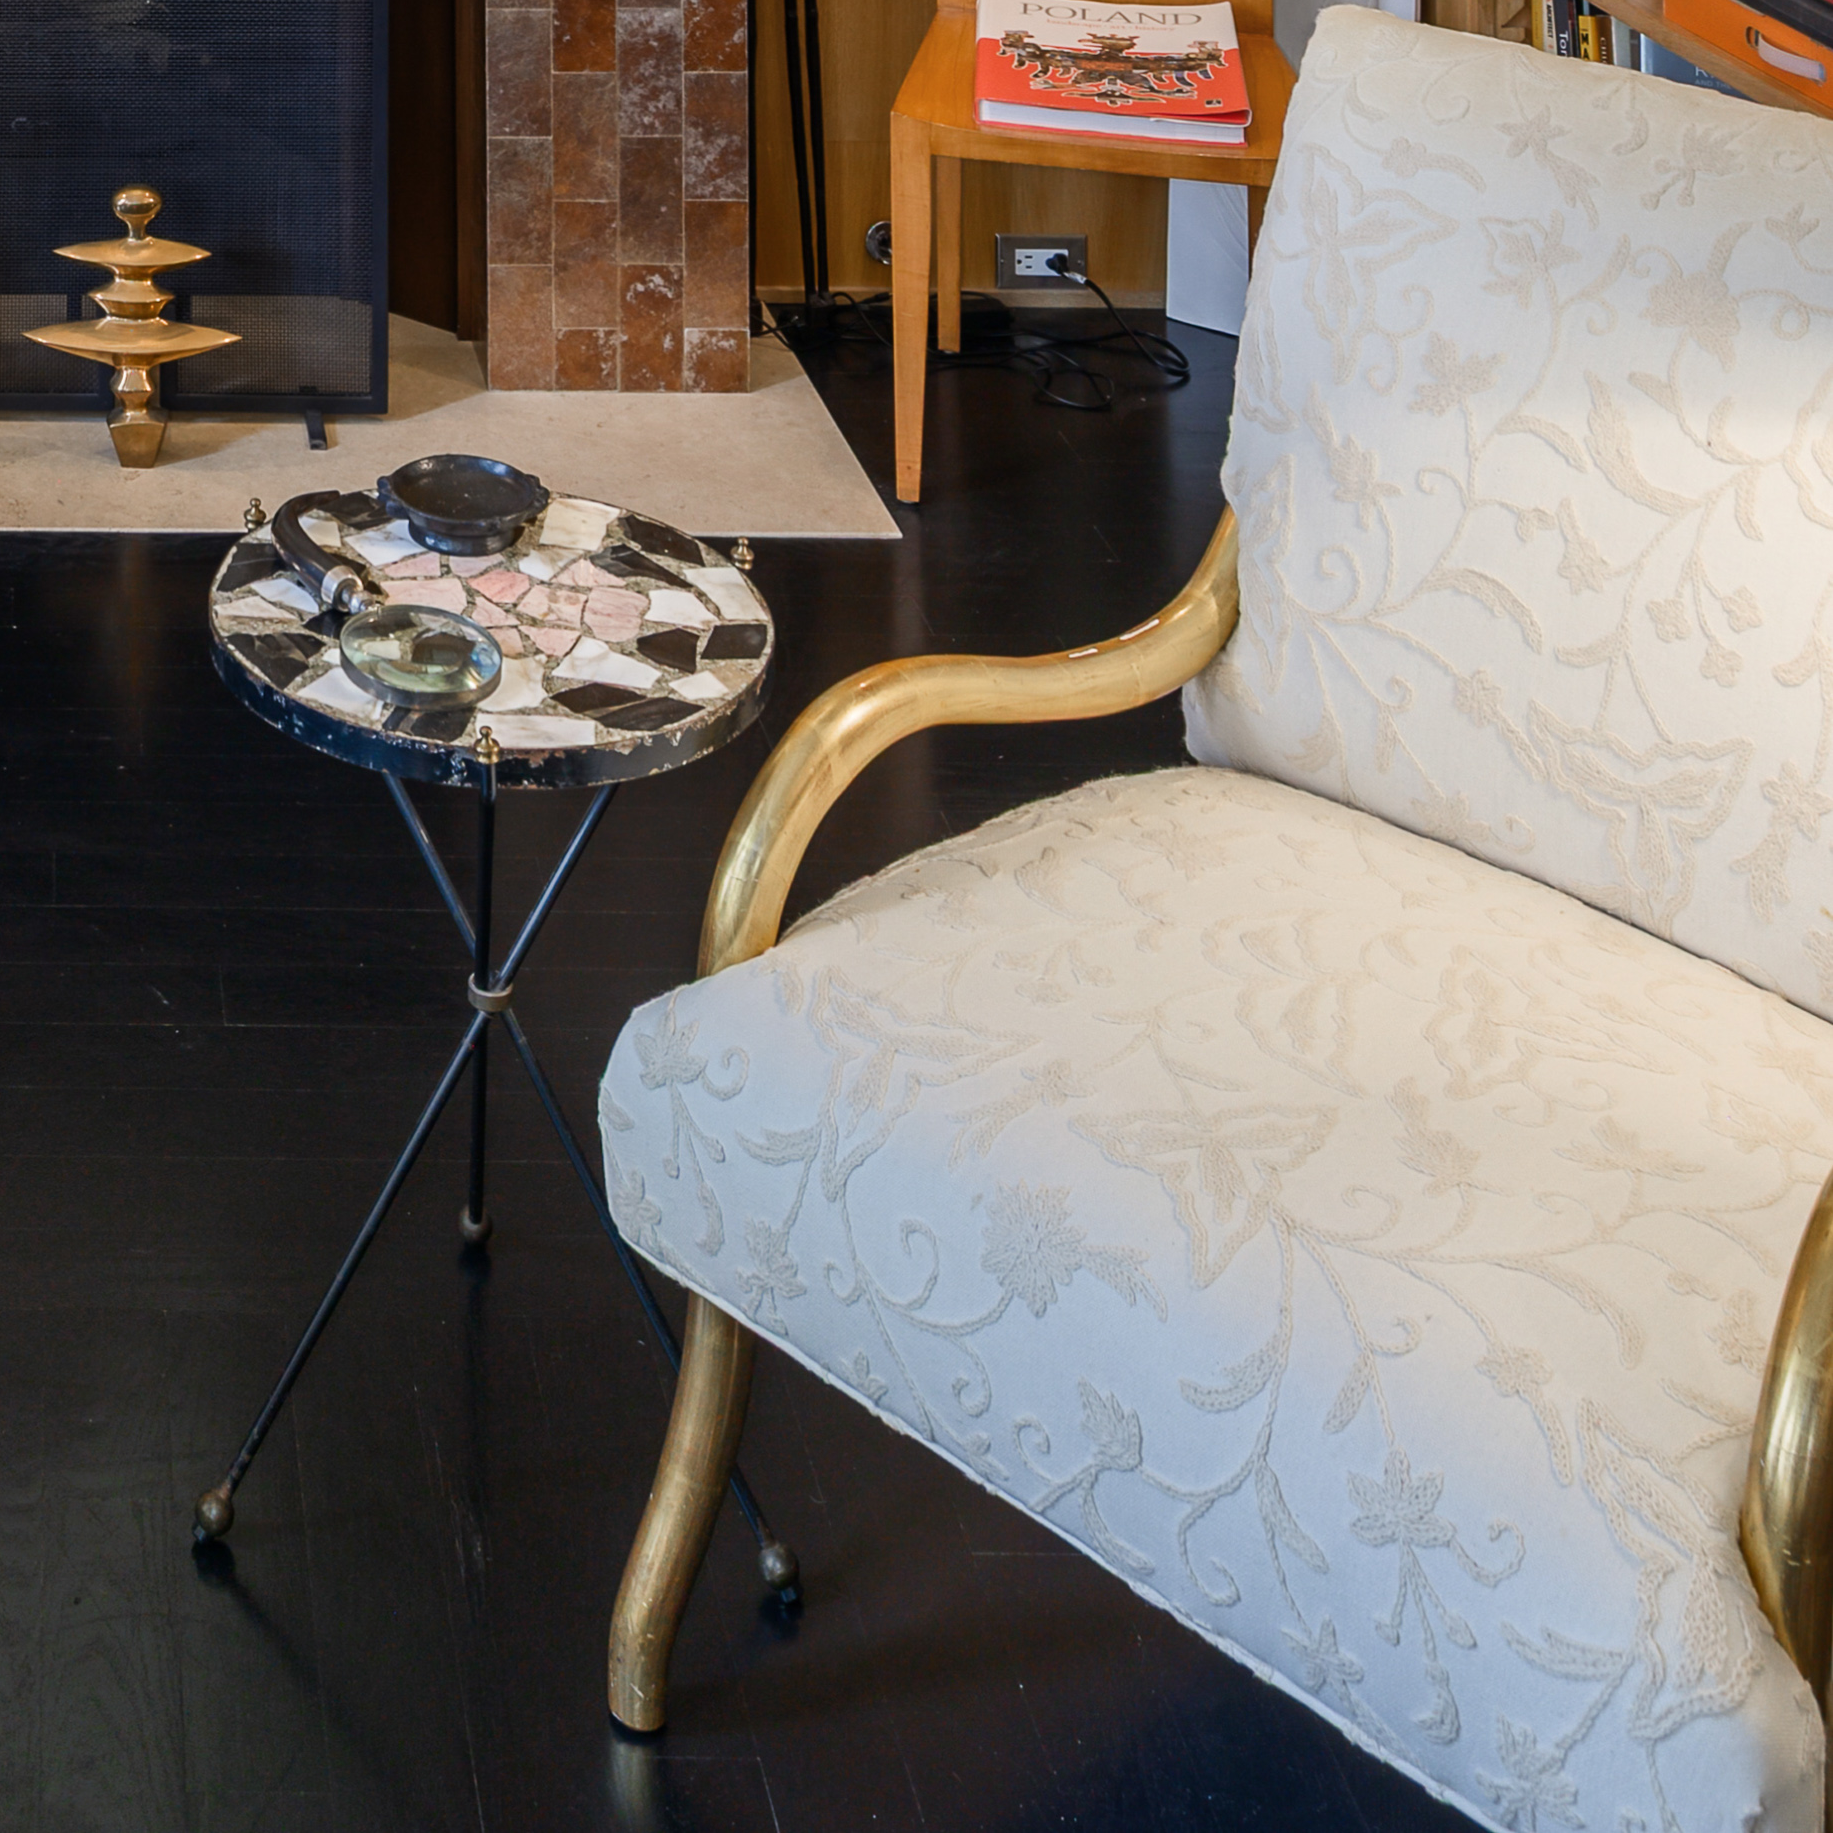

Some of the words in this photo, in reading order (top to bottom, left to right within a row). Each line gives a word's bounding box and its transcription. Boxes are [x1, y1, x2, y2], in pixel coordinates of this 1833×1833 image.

[1019, 2, 1202, 26] POLAND
[1545, 3, 1553, 38] ARCHITECT
[1695, 77, 1713, 85] AND
